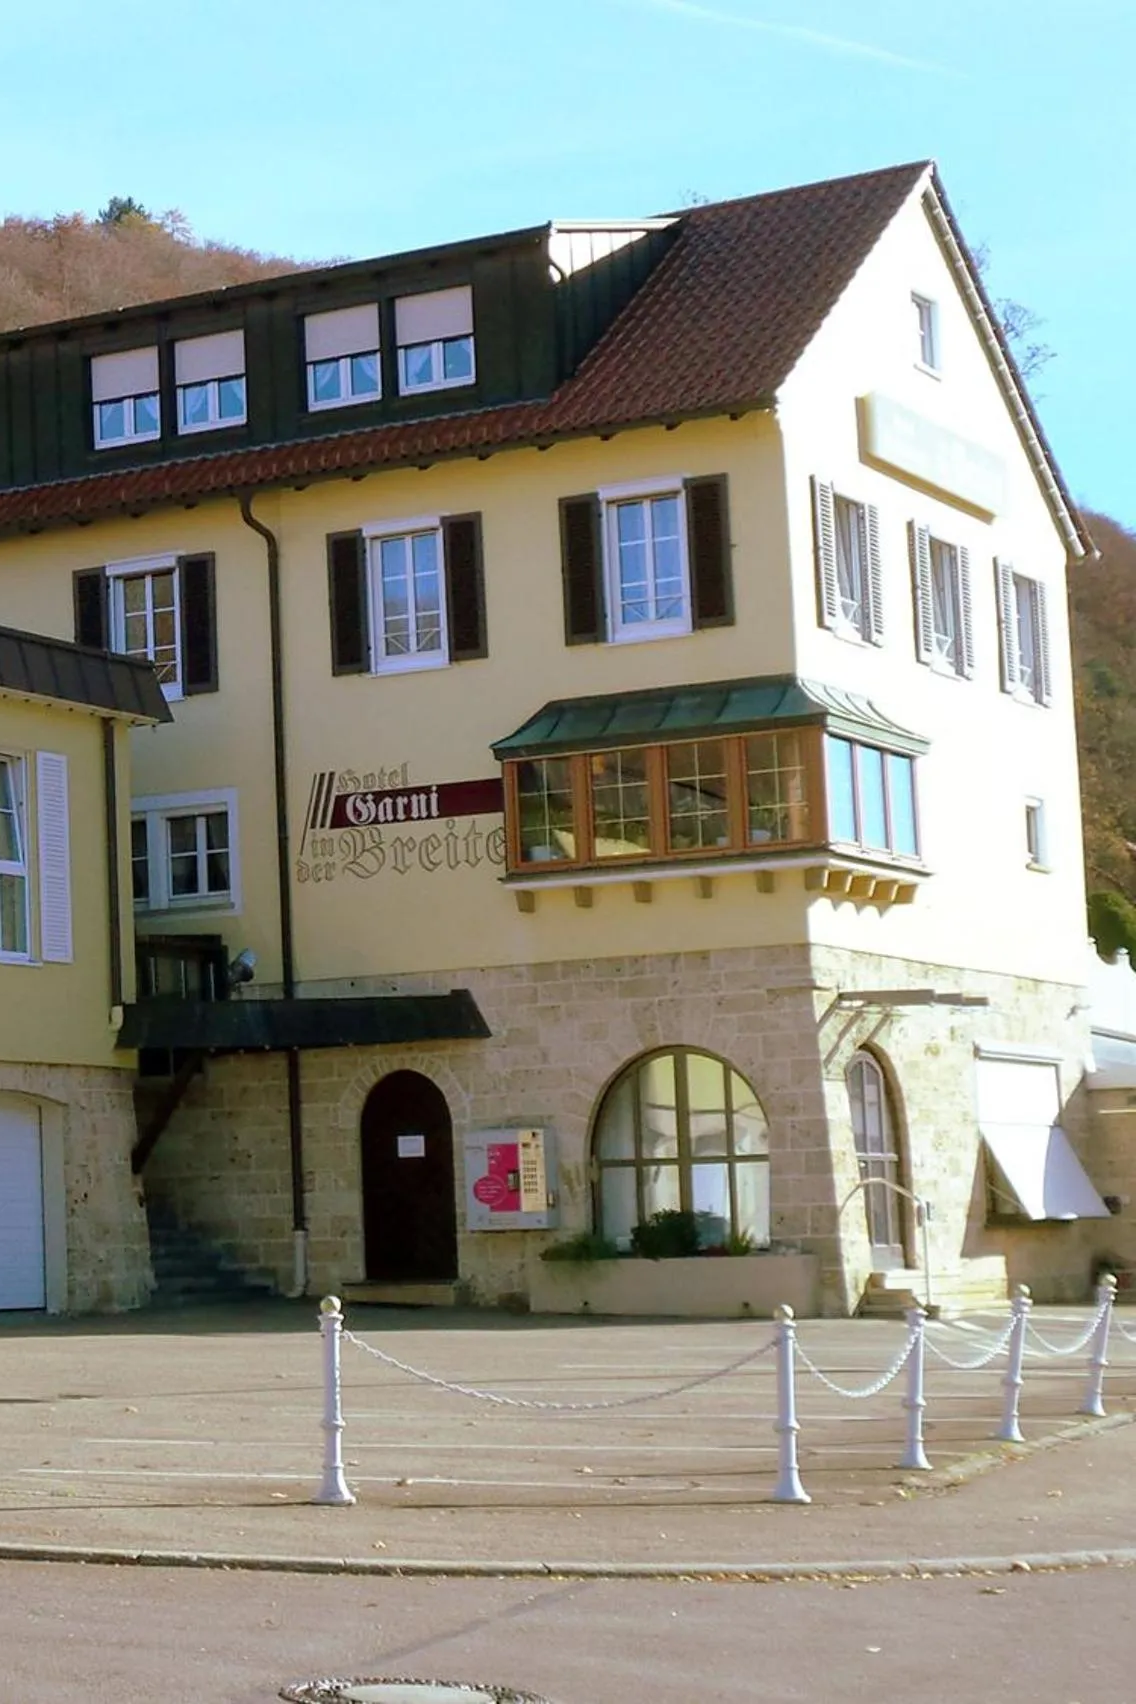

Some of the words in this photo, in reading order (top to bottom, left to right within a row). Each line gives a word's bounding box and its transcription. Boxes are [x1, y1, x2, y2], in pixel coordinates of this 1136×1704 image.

[345, 784, 441, 826] Garni
[311, 831, 335, 859] in
[338, 818, 508, 880] Breite
[296, 858, 337, 883] der
